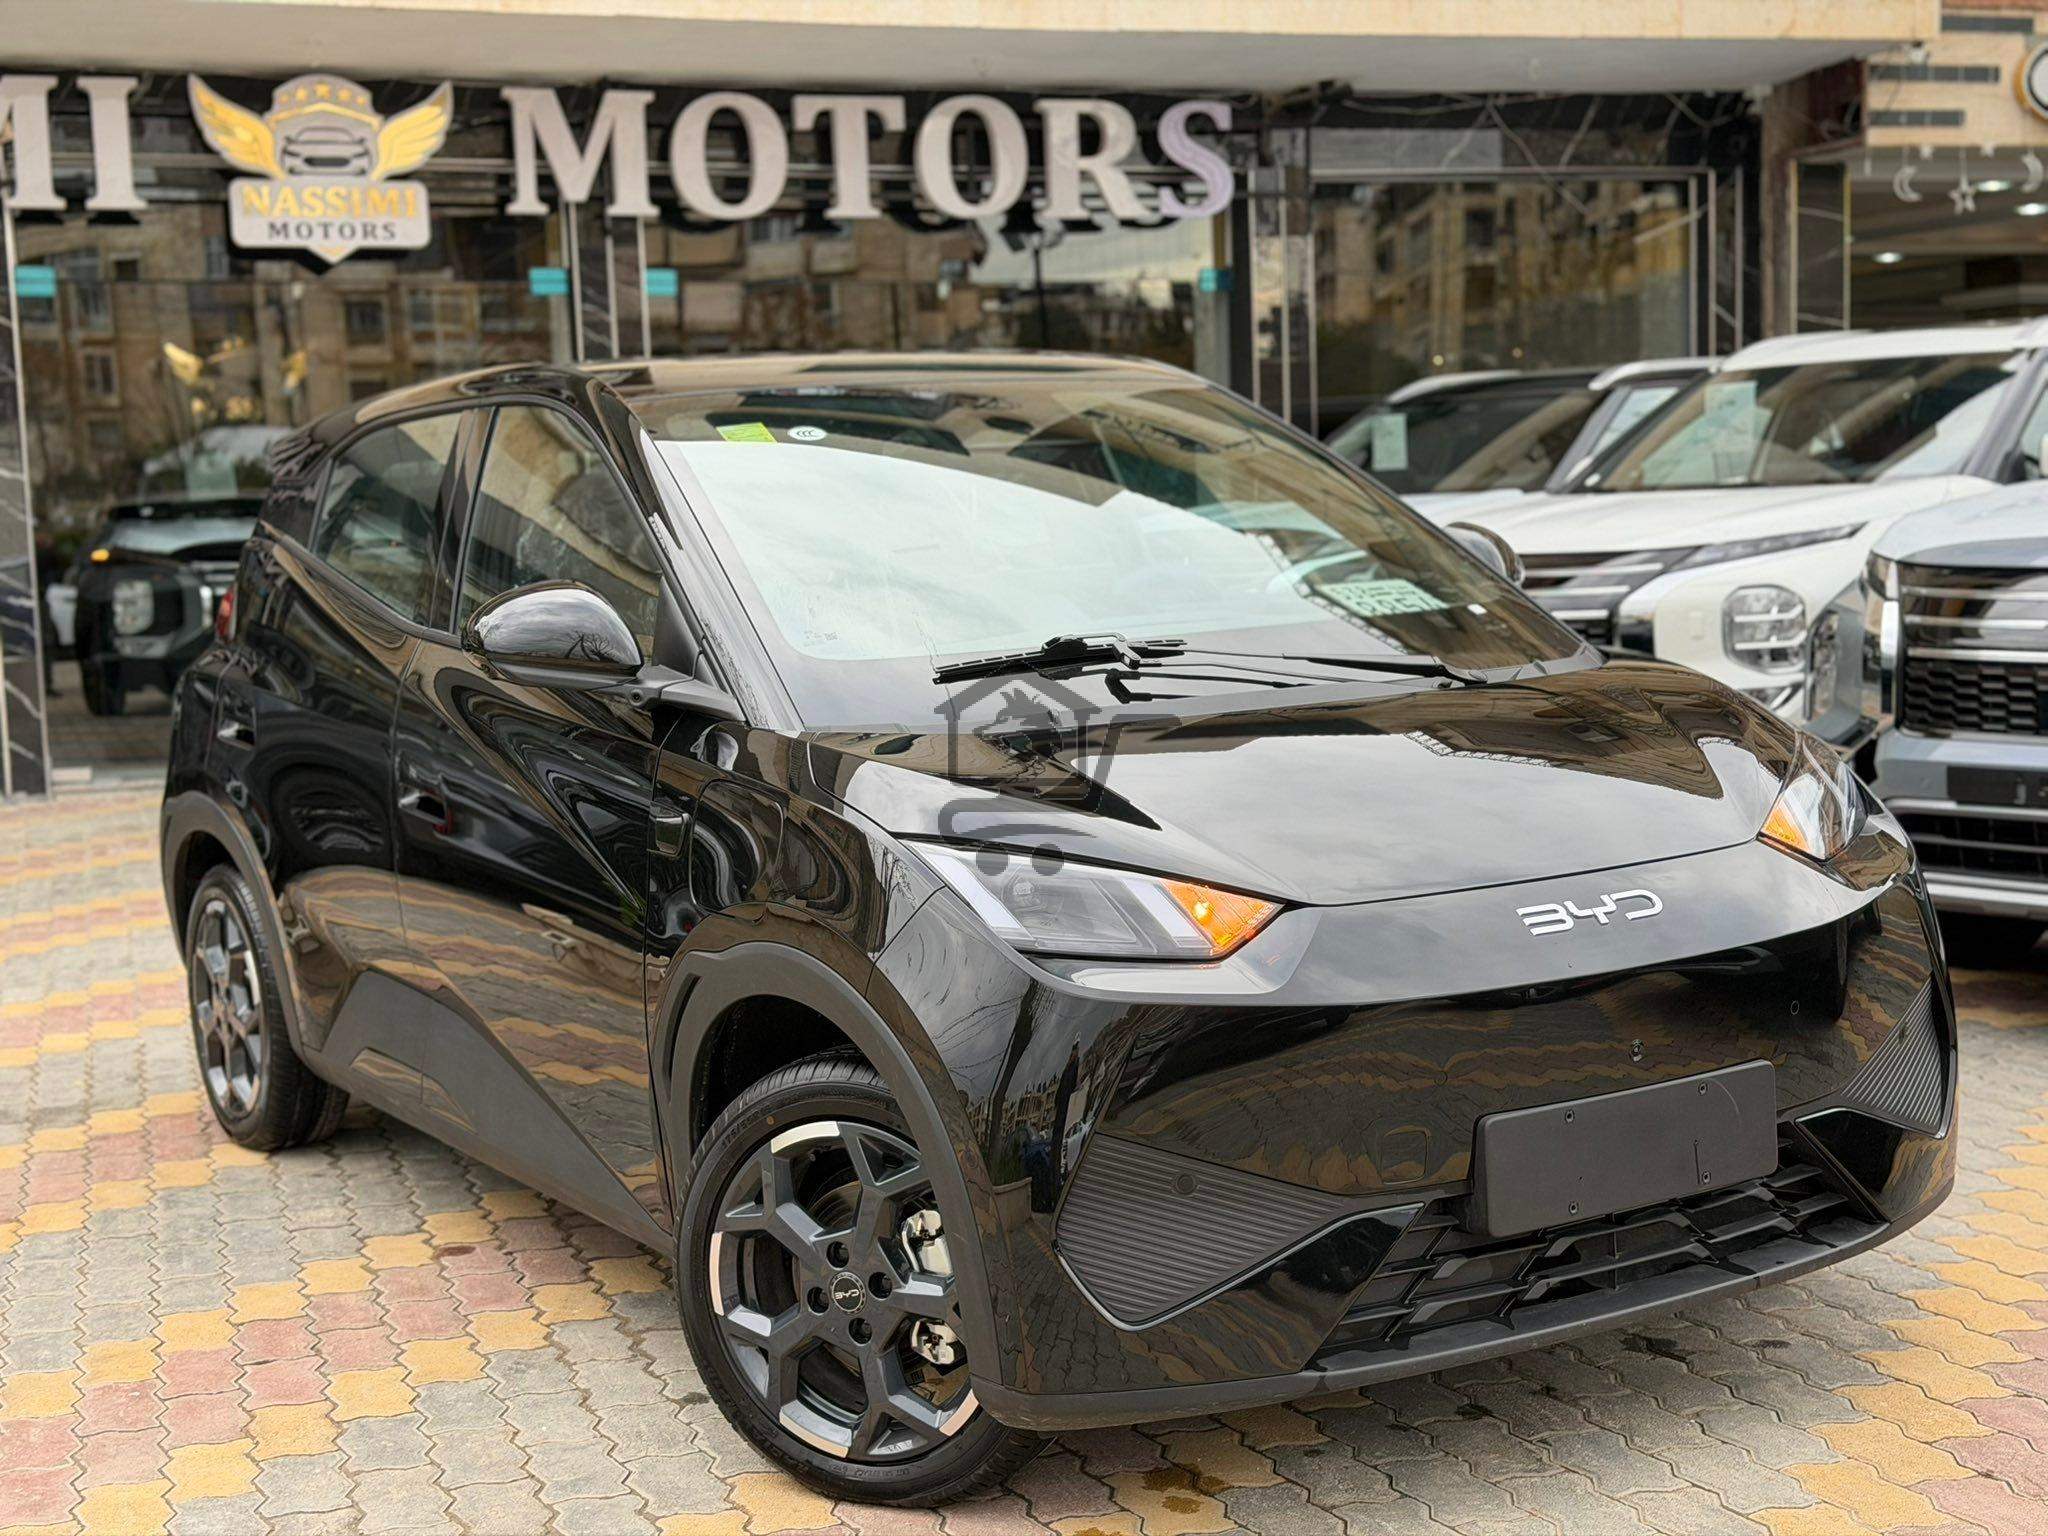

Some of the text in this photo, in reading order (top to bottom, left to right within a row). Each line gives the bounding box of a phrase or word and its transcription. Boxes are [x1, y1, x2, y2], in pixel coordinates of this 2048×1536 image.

[502, 87, 1235, 219] MOTORS
[242, 184, 417, 219] NASSIMI
[268, 222, 396, 241] MOTORS
[1516, 889, 1663, 936] BYD
[834, 1288, 860, 1300] BYD
